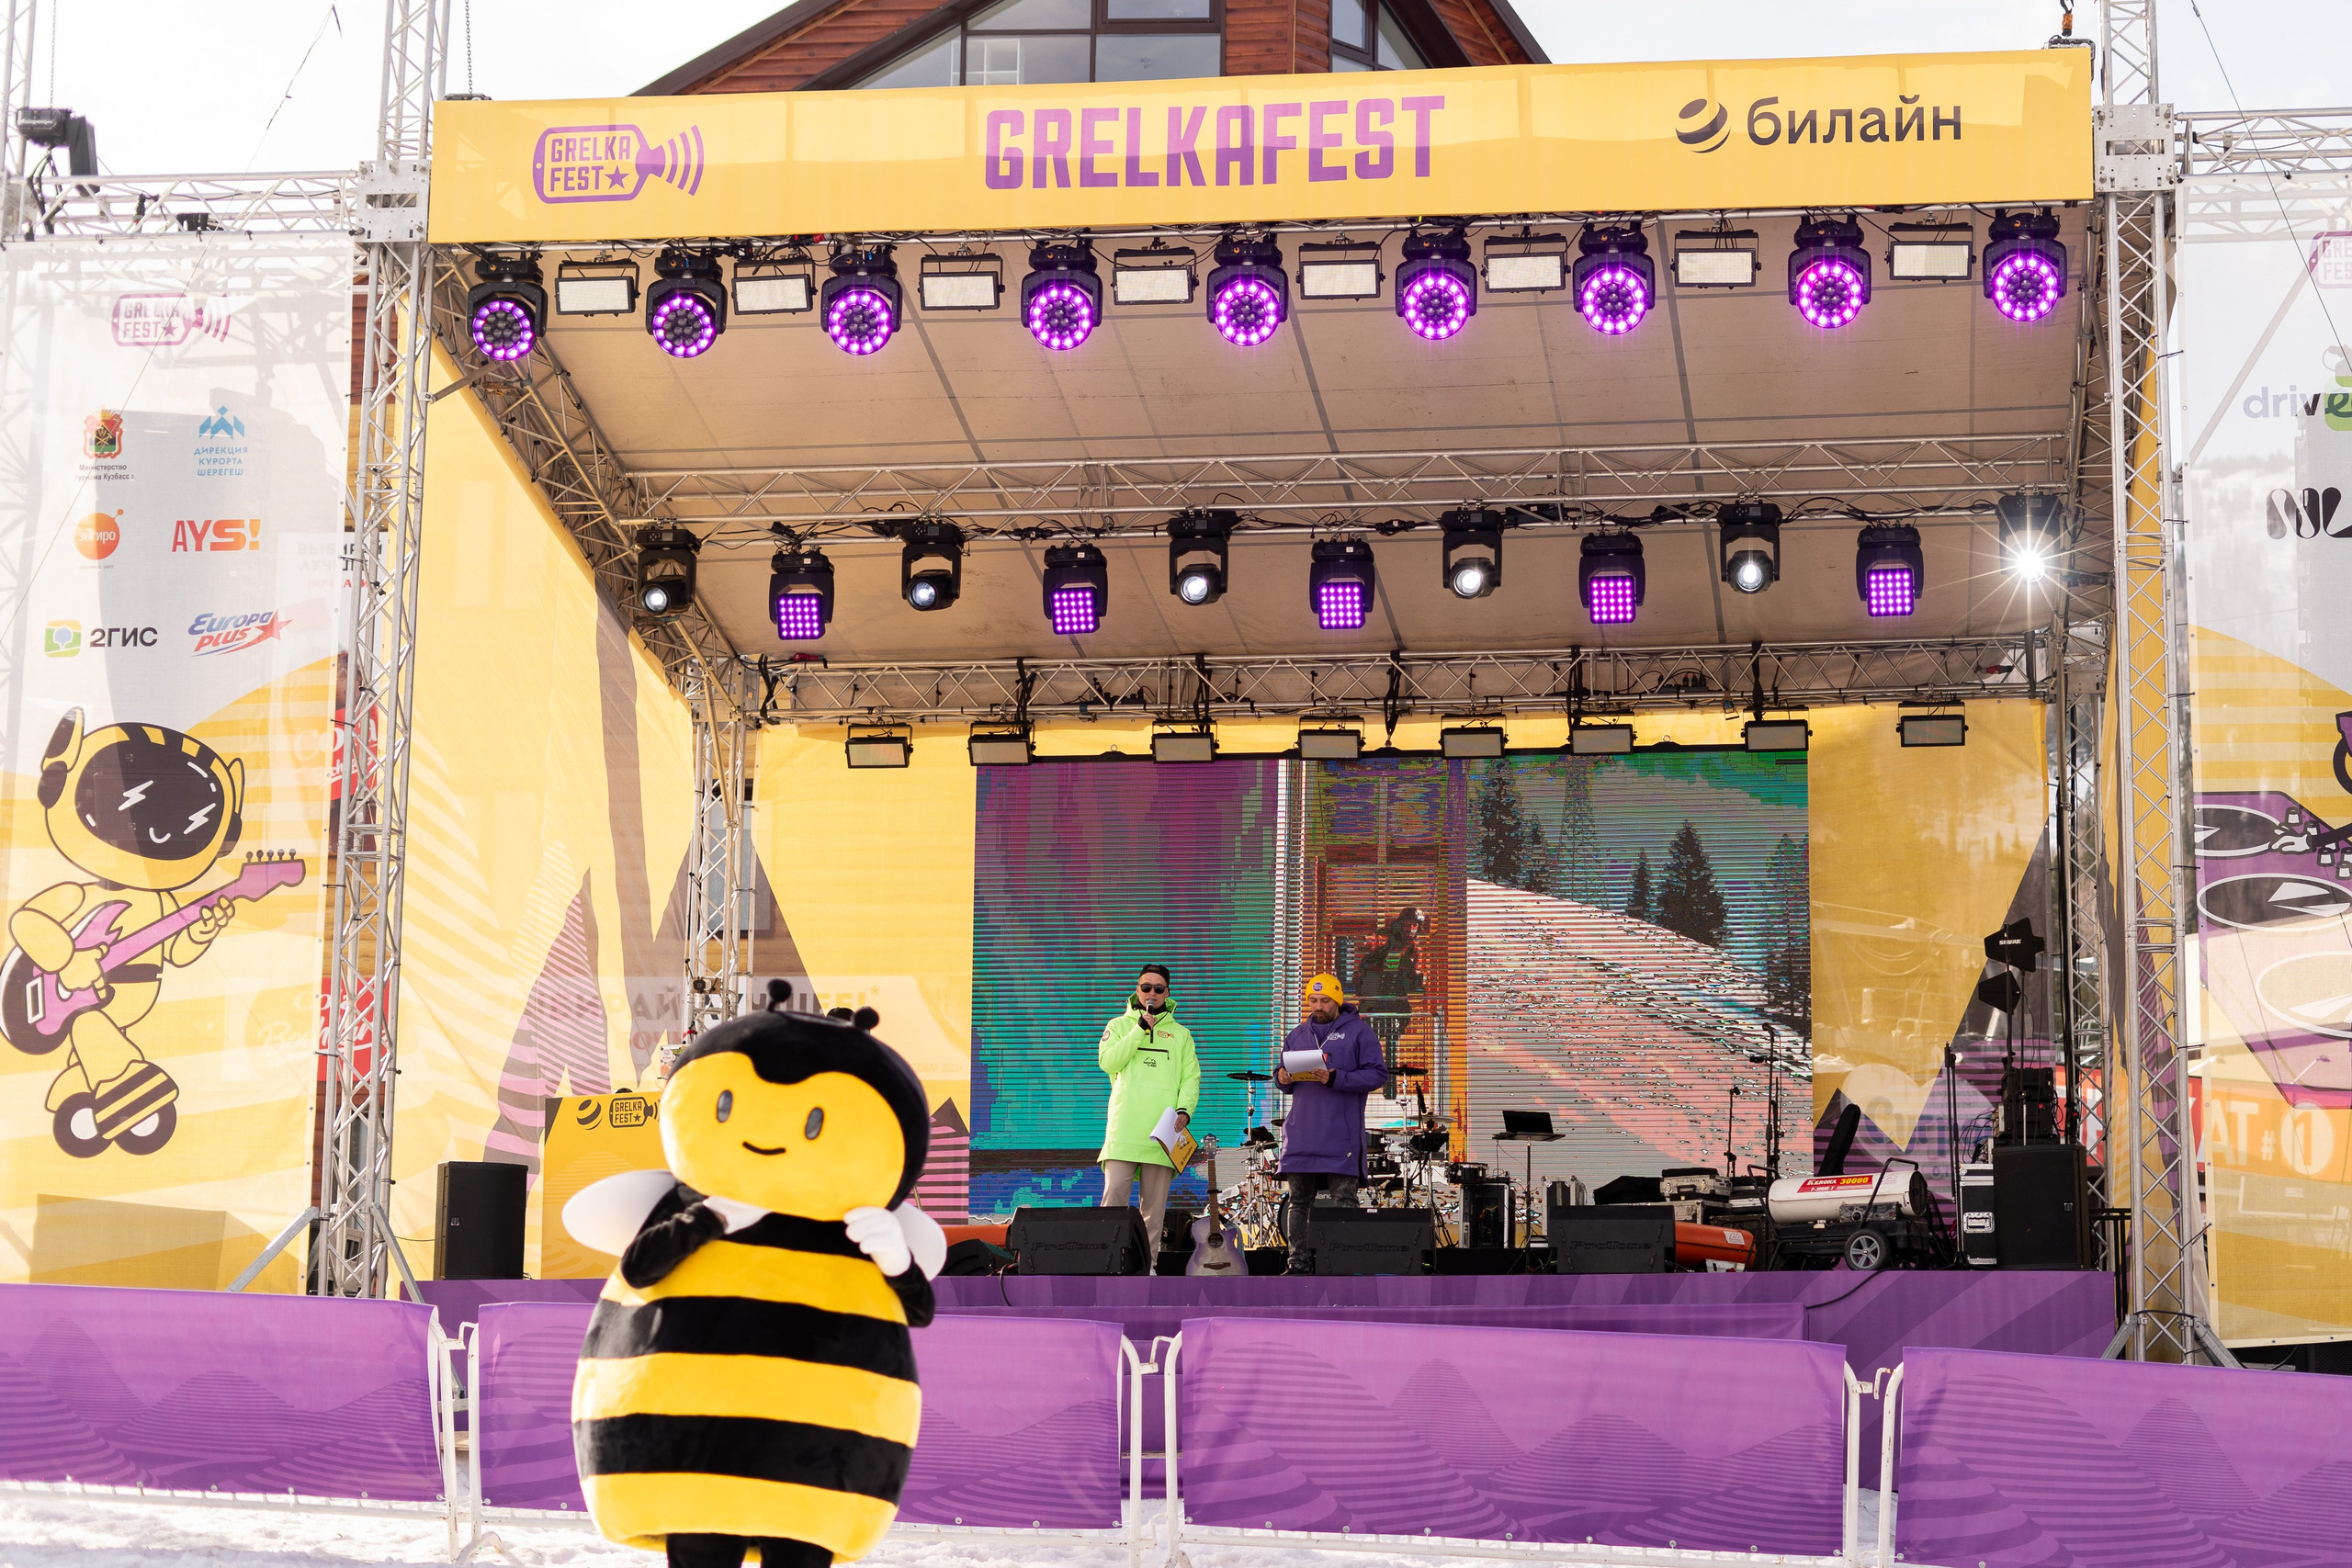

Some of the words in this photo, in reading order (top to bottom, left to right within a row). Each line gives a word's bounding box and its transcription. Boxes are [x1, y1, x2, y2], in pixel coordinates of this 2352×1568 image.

[1747, 94, 1962, 146] билайн
[550, 135, 631, 164] GRELKA
[985, 95, 1446, 190] GRELKAFEST
[549, 165, 605, 193] FEST
[122, 321, 162, 339] FEST
[2243, 385, 2352, 419] drive
[193, 446, 248, 456] ДИРЕКЦИЯ
[79, 464, 127, 472] Министерство
[198, 457, 243, 466] КУРОРТА
[197, 468, 243, 477] ШЕРЕГЕШ
[79, 531, 116, 544] энгиро
[172, 518, 261, 552] AYS!
[187, 611, 274, 636] Europa
[89, 626, 159, 648] 2ГИС
[615, 1100, 642, 1112] GRELKA
[615, 1112, 634, 1123] FEST
[1839, 1177, 1870, 1185] 30000
